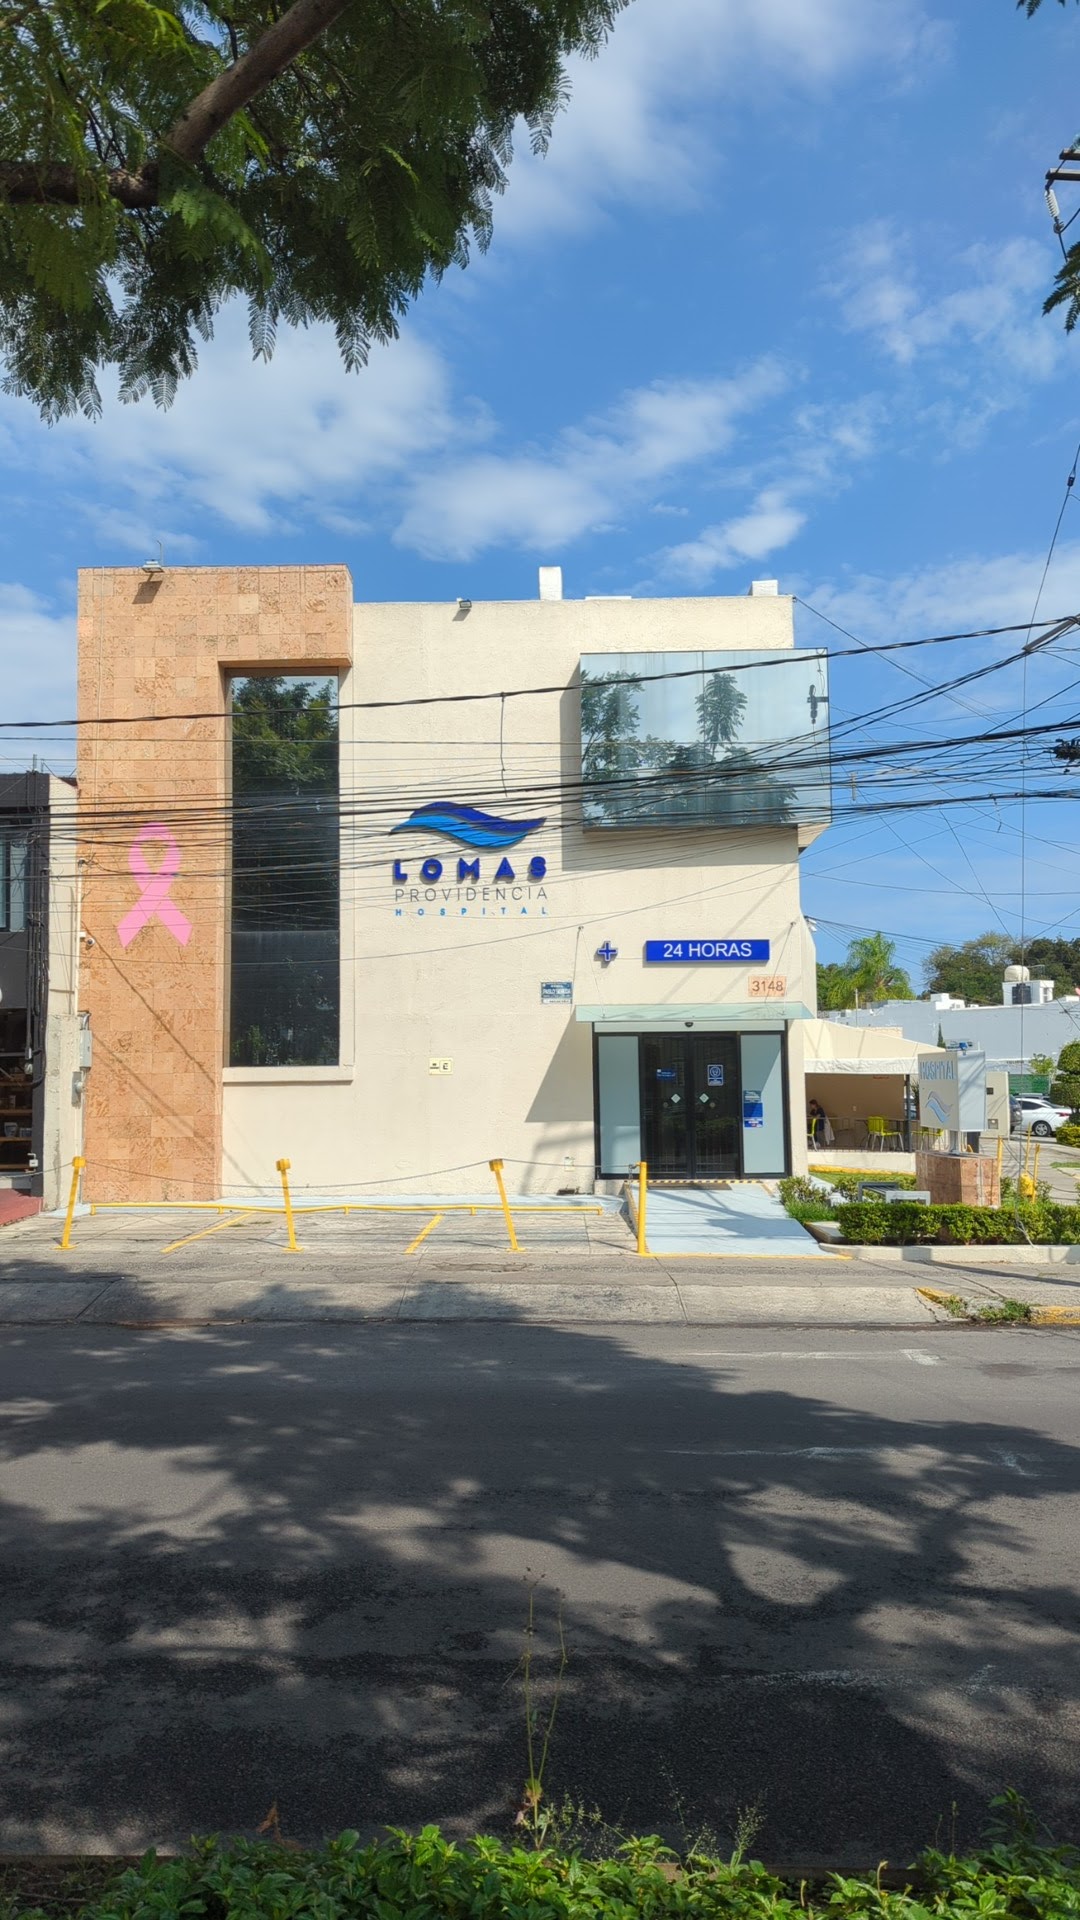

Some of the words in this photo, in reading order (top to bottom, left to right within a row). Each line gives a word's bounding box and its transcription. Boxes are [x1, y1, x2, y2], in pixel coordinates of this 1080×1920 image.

[394, 856, 547, 881] LOMAS
[395, 887, 548, 902] PROVIDENCIA
[396, 907, 548, 916] HOSPITAL
[663, 943, 683, 957] 24
[688, 943, 752, 957] HORAS
[752, 980, 783, 991] 3148
[920, 1060, 955, 1080] HOSPITAL
